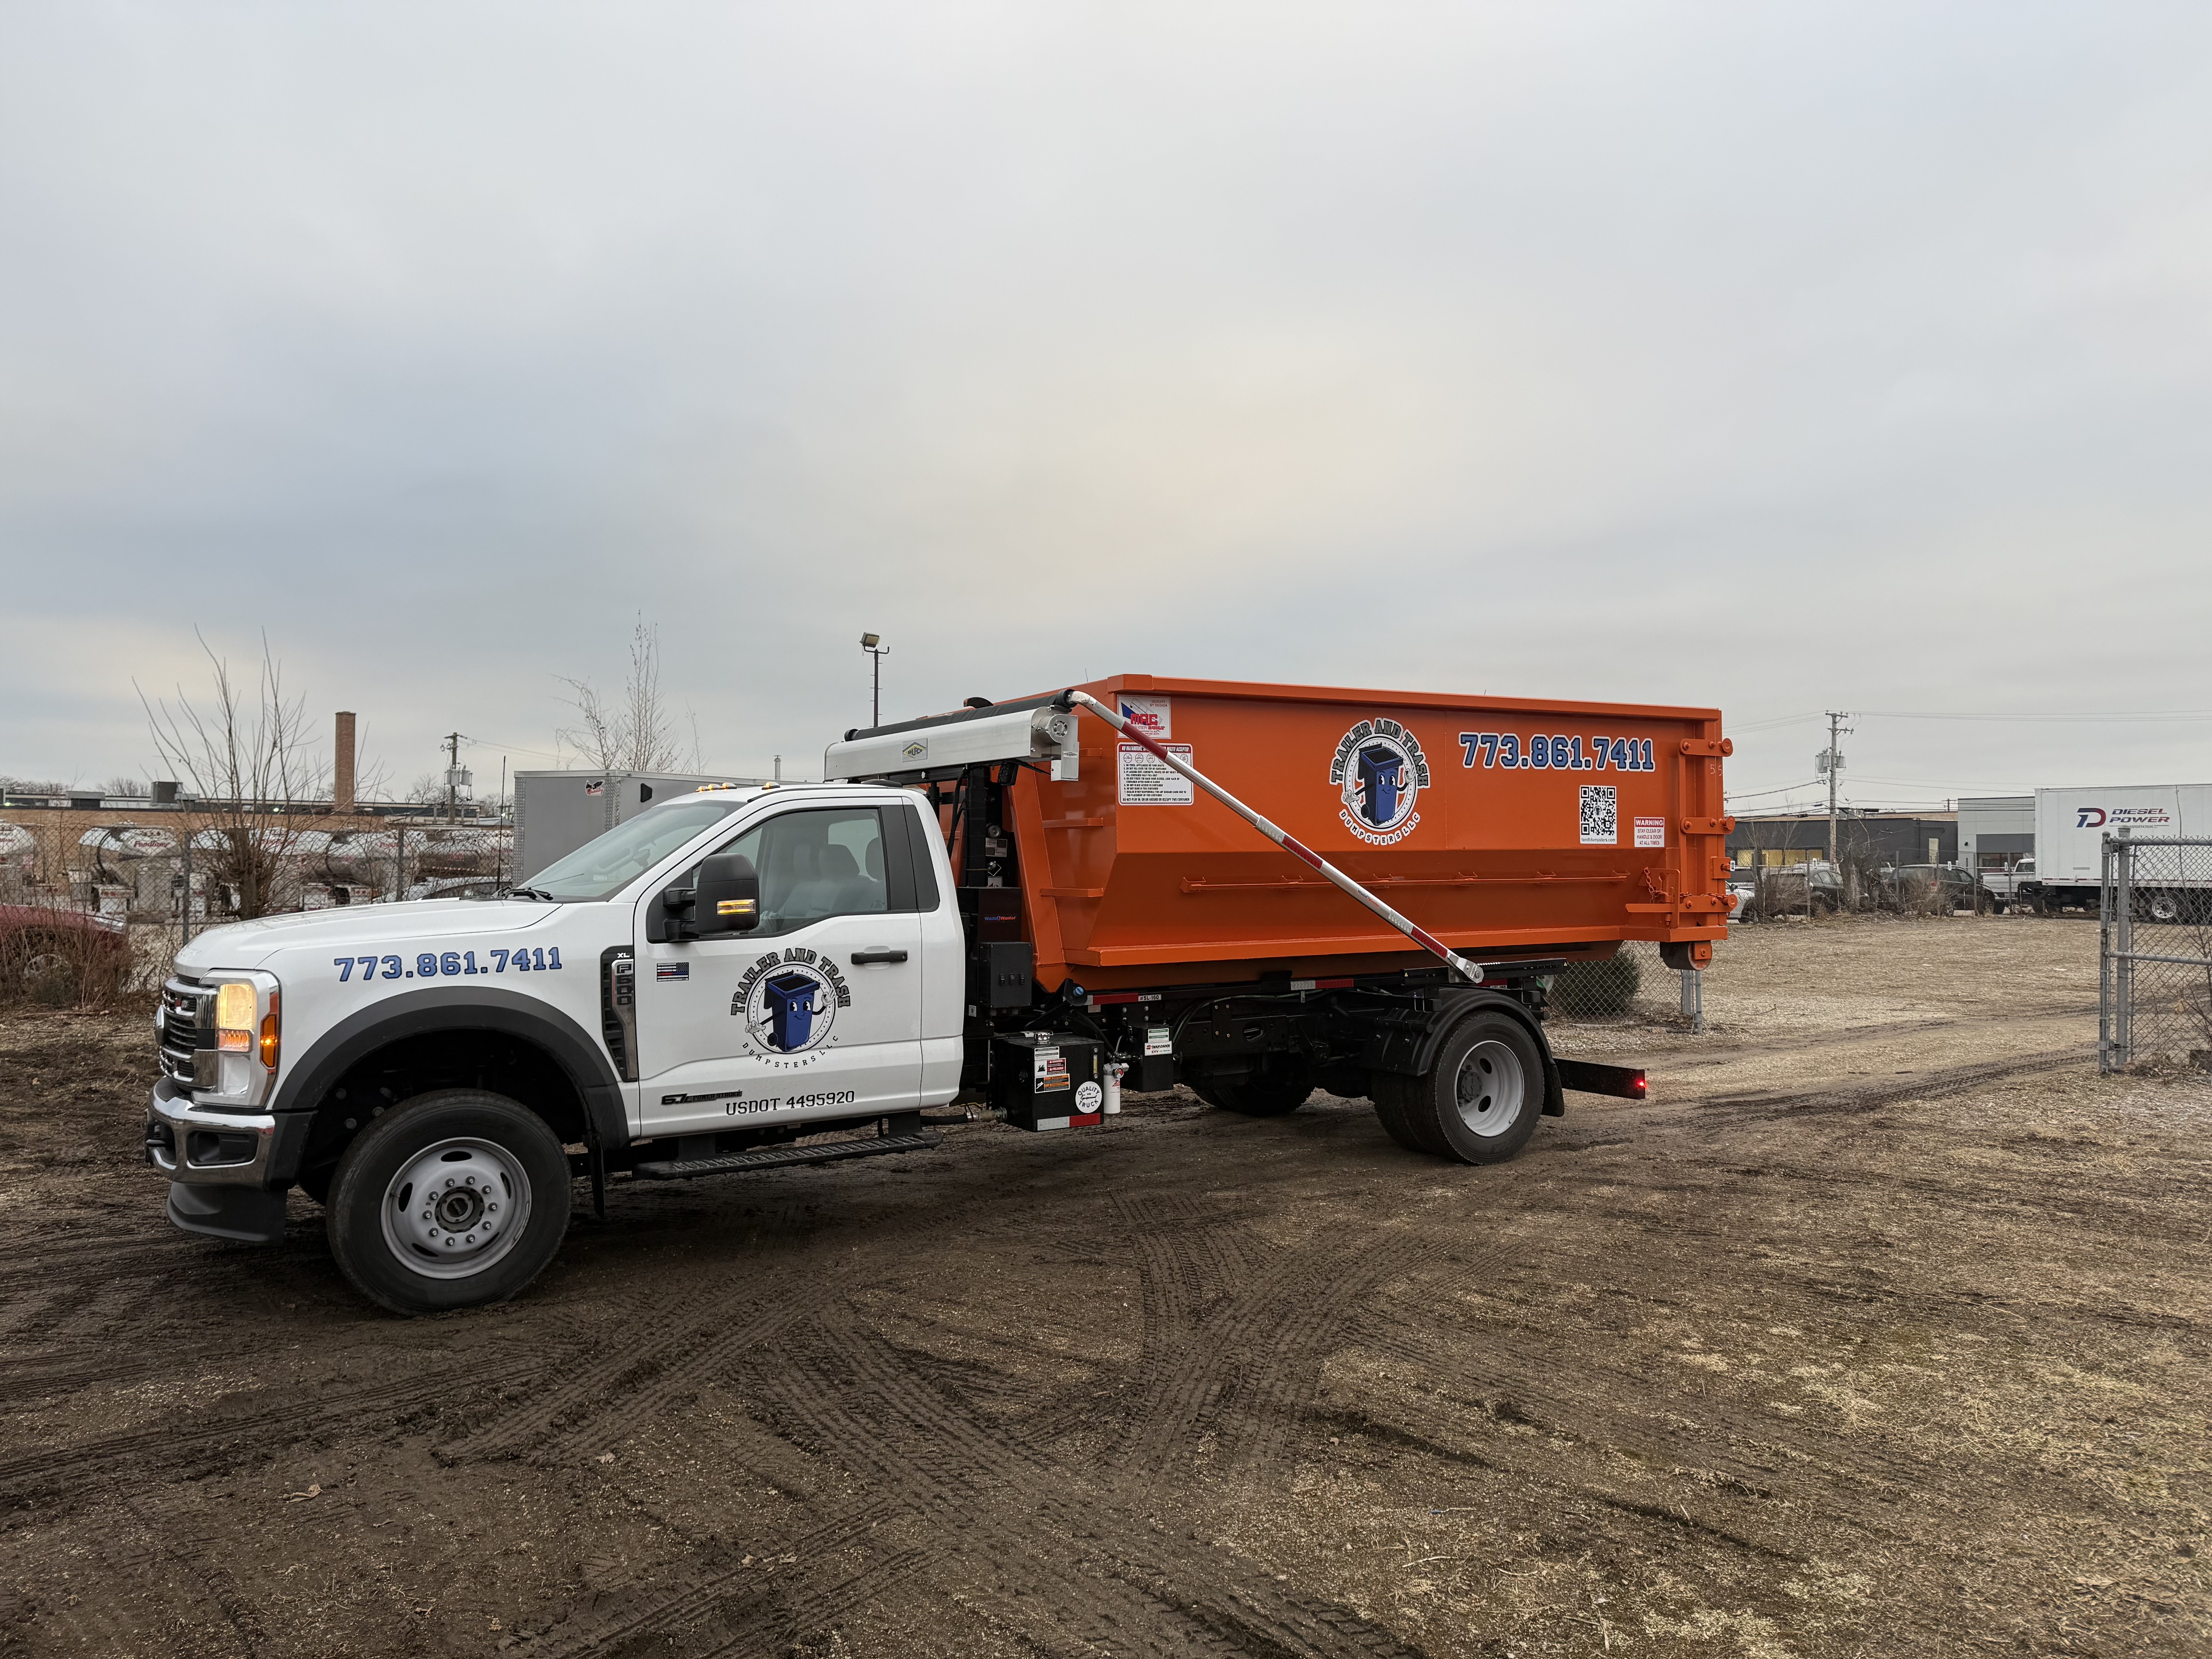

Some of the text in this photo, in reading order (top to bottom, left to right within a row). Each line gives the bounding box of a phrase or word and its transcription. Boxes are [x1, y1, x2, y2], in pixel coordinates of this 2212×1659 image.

[1130, 713, 1158, 725] MAC
[1331, 720, 1429, 787] TRAILER AND TRASH
[1460, 733, 1655, 771] 773.861.7411
[1341, 811, 1419, 843] DUMPSTERS LLC
[334, 947, 562, 982] 773.861.7411
[731, 948, 851, 1015] TRAILER AND TRASH
[742, 1035, 838, 1068] DUMPSTERS LLC
[726, 1091, 855, 1116] USDOT 4495920
[1078, 1086, 1100, 1096] QUALITY
[1079, 1099, 1099, 1108] TRUCK
